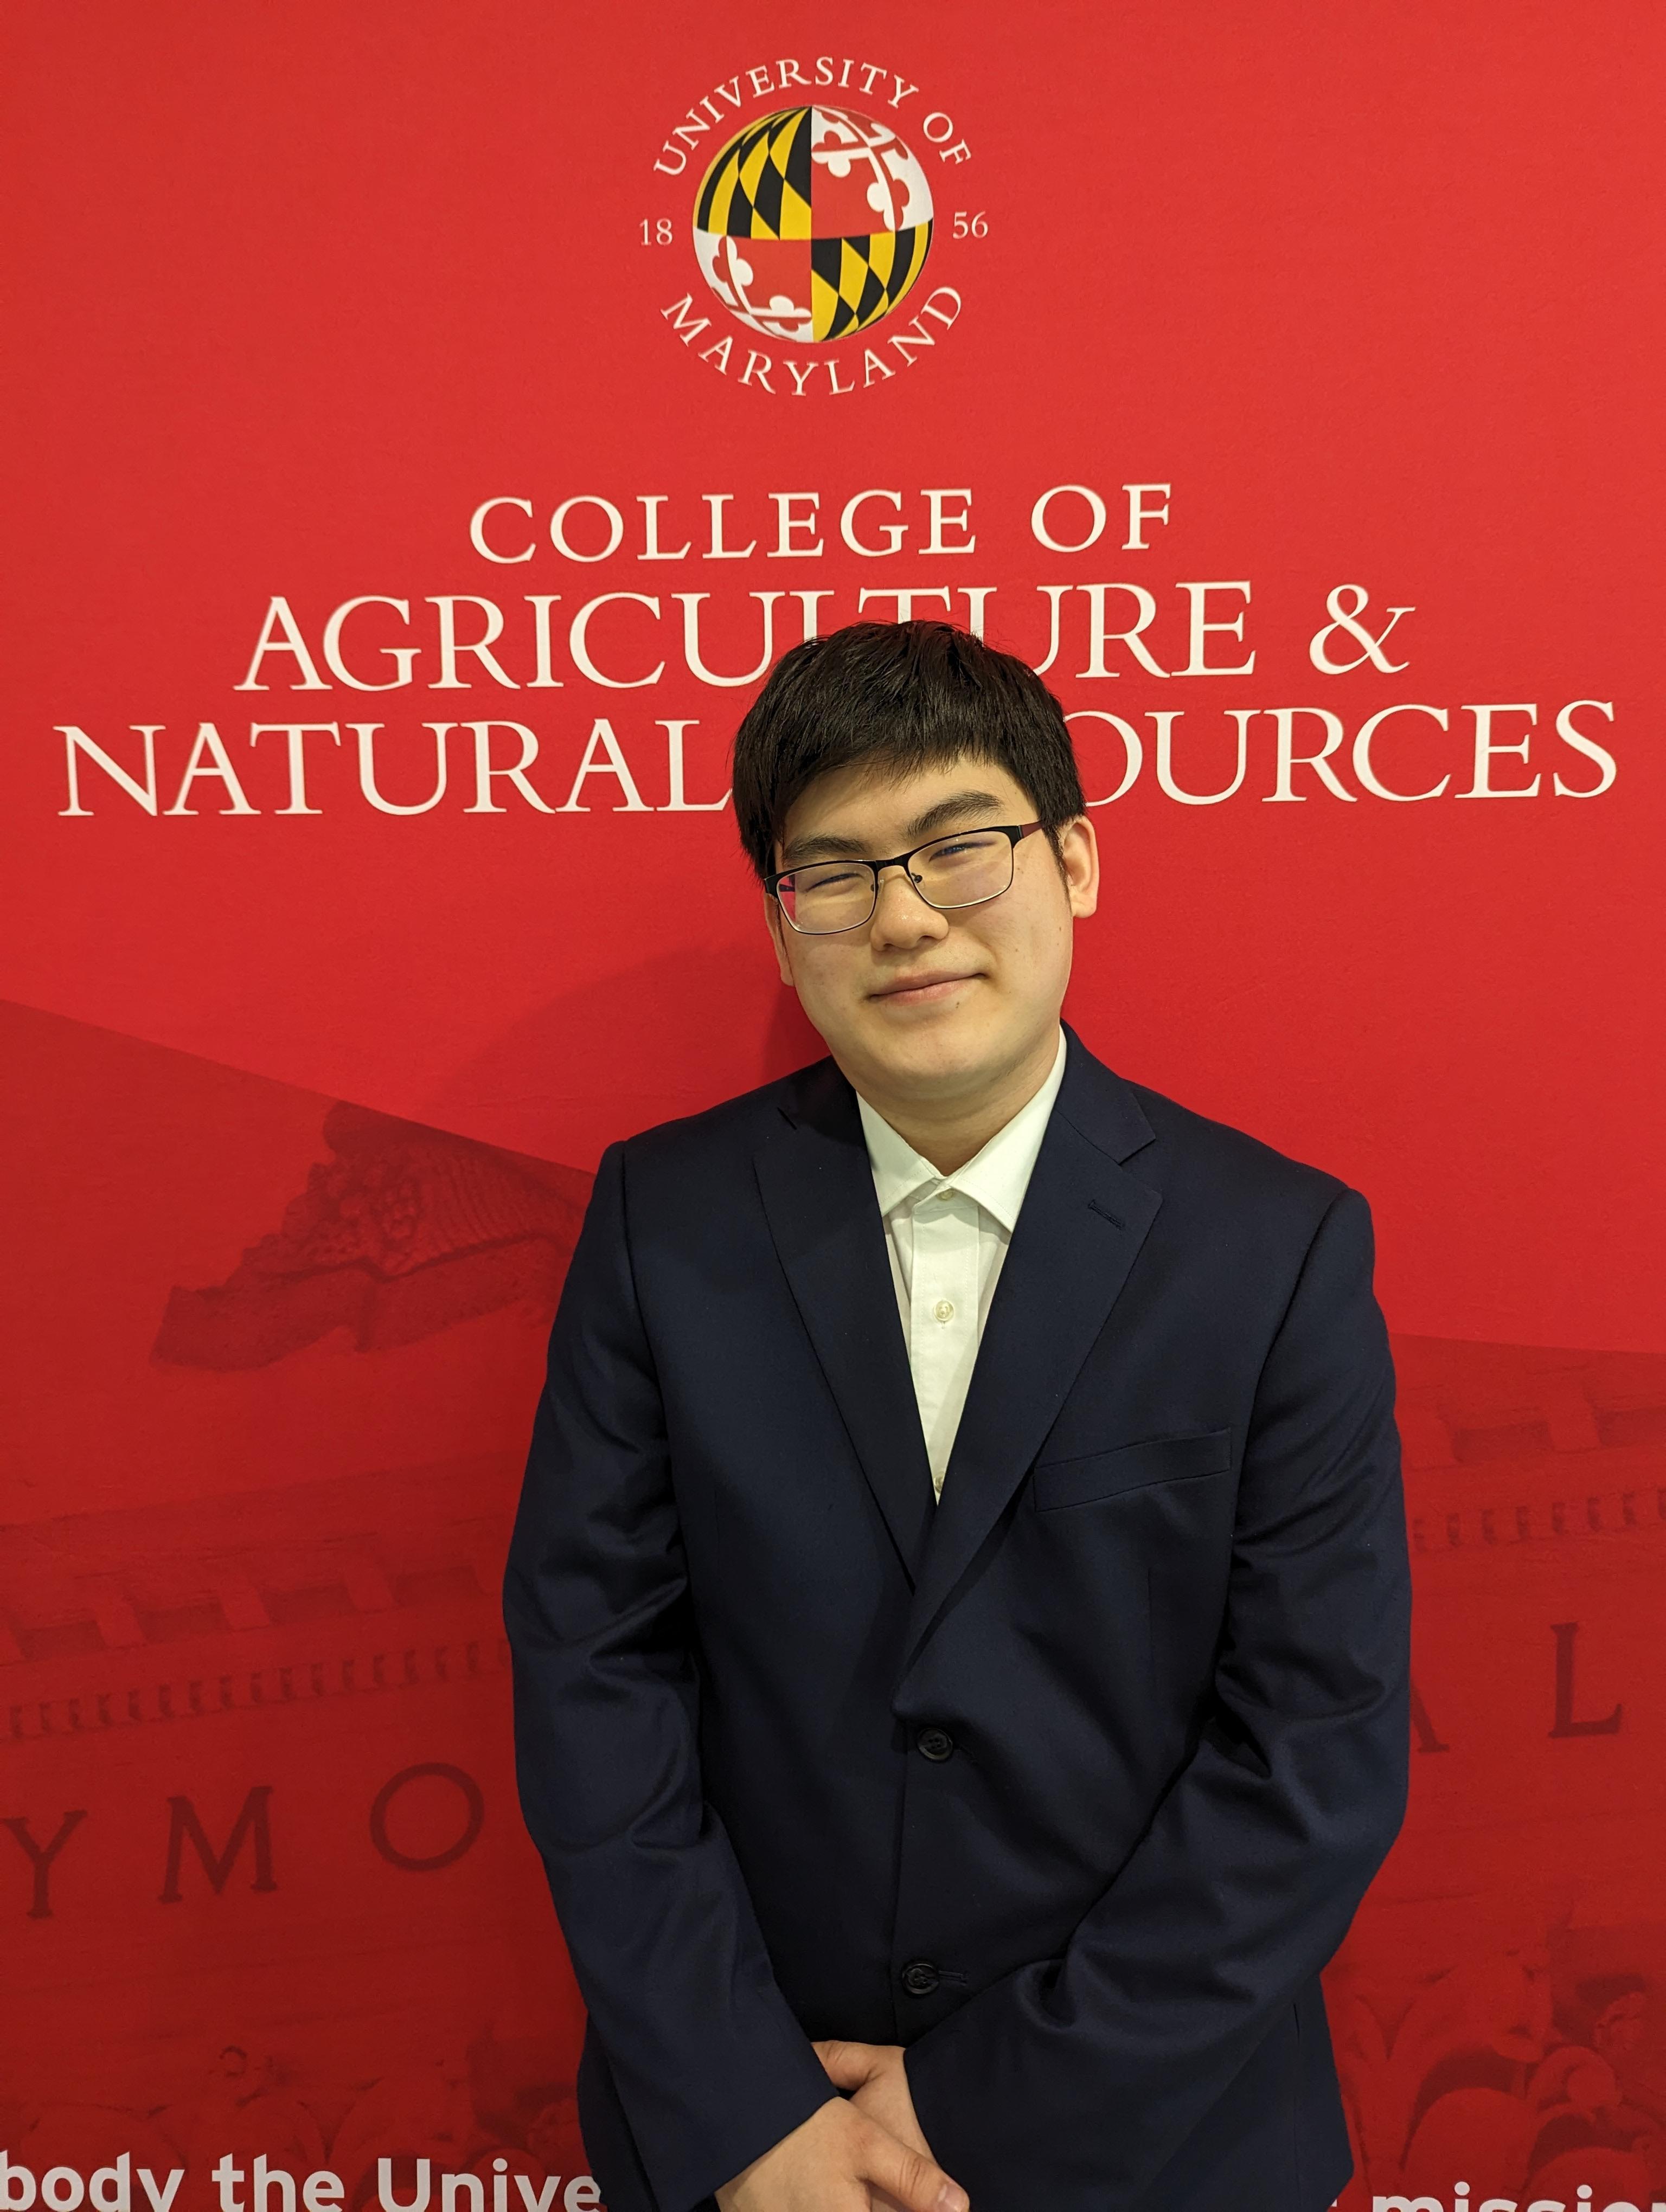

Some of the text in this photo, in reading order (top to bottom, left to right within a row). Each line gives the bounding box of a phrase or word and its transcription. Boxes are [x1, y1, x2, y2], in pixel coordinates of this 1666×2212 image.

[653, 56, 972, 177] UNIVERSITY OF
[639, 211, 989, 246] 18 56
[660, 286, 962, 397] MARYLAND
[470, 483, 1171, 564] COLLEGE OF
[1309, 583, 1416, 675] &
[53, 699, 1617, 817] NATURAL OURCES
[212, 2153, 345, 2212] the
